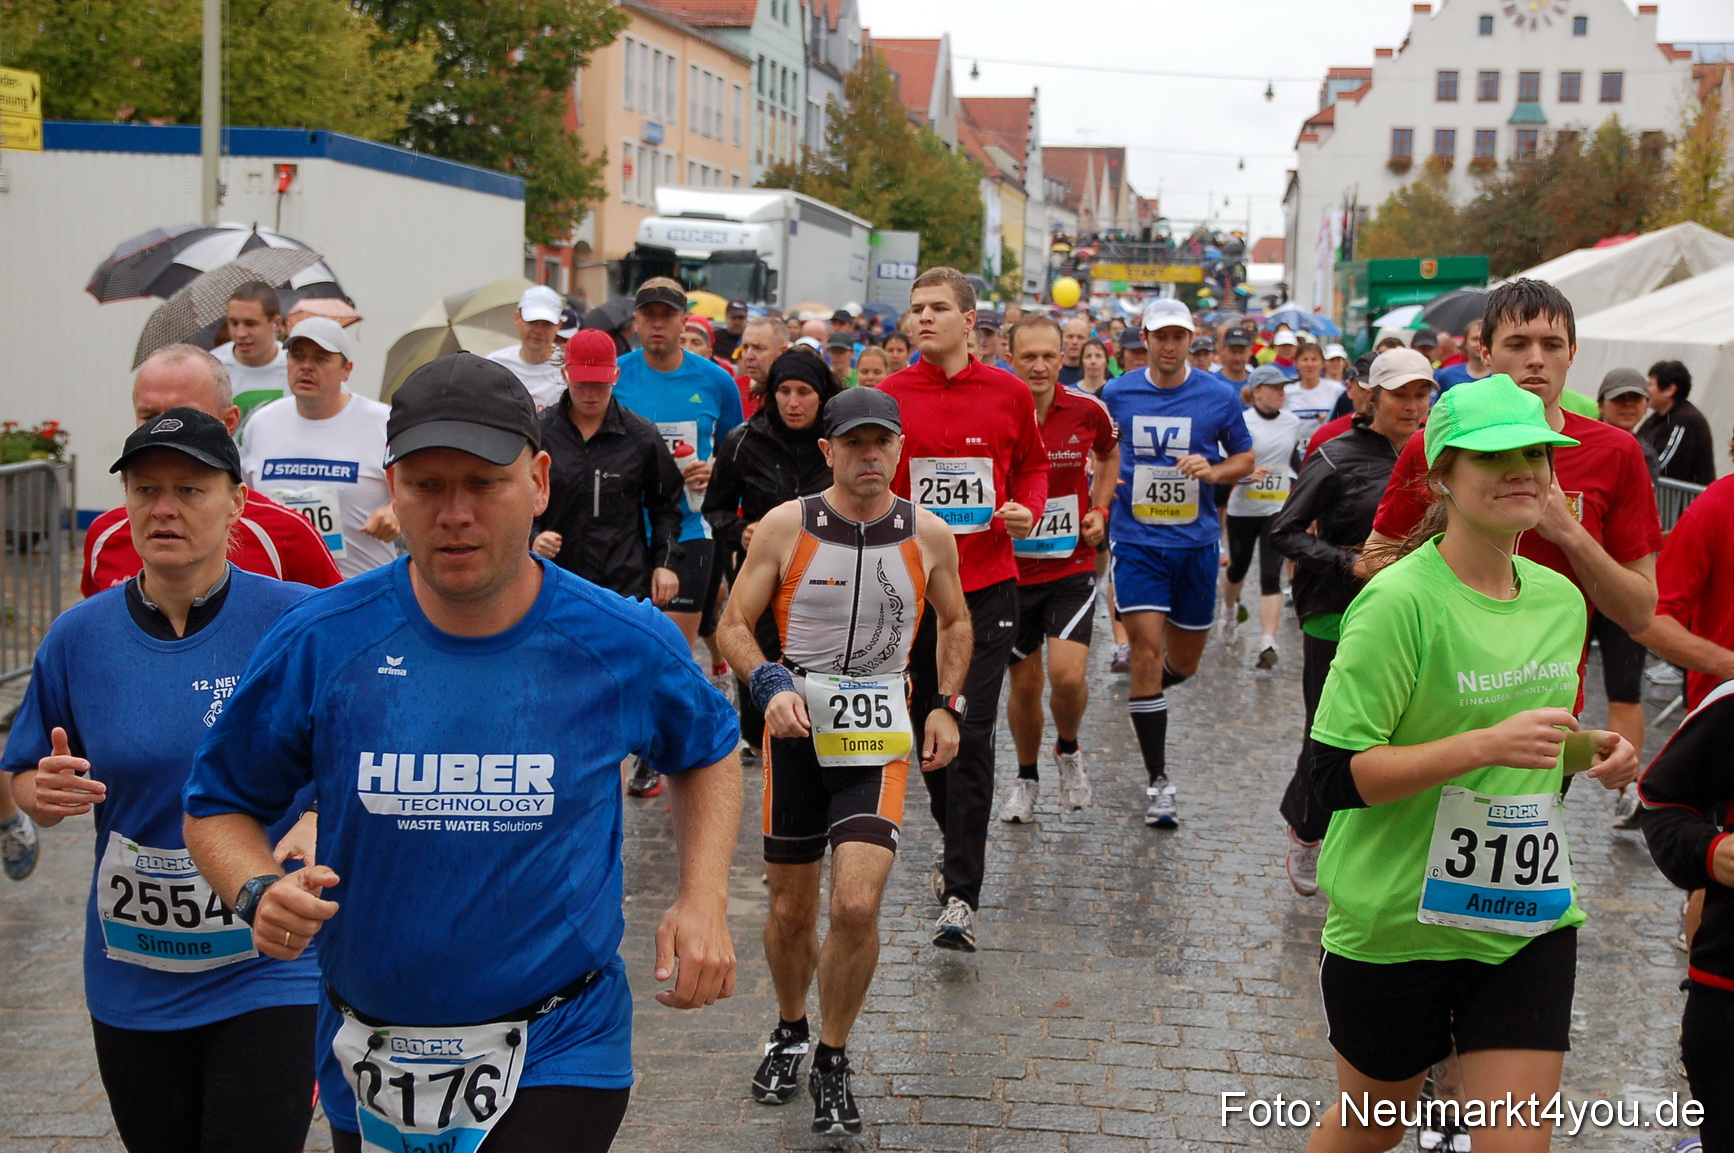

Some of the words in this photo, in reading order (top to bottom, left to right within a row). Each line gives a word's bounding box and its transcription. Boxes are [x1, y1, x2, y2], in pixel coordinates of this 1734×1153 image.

[274, 463, 351, 478] STAEDTLER
[919, 477, 984, 505] 2541
[1146, 482, 1186, 503] 435
[1150, 507, 1180, 516] Florian
[378, 667, 407, 676] erima
[192, 680, 213, 691] 12.
[828, 693, 893, 730] 295
[841, 737, 884, 752] Tomas
[357, 752, 555, 793] HUBER
[397, 798, 546, 812] TECHNOLOGY
[1488, 803, 1539, 819] BOCK
[397, 820, 441, 831] WASTE
[445, 821, 490, 831] WATER
[493, 820, 543, 832] Solutions
[135, 855, 194, 871] BOCK
[1445, 827, 1560, 886] 3192
[110, 874, 234, 929] 2554
[1465, 892, 1538, 917] Andrea
[137, 933, 212, 956] Simone
[391, 1037, 464, 1056] BOCK
[352, 1061, 502, 1129] 2176
